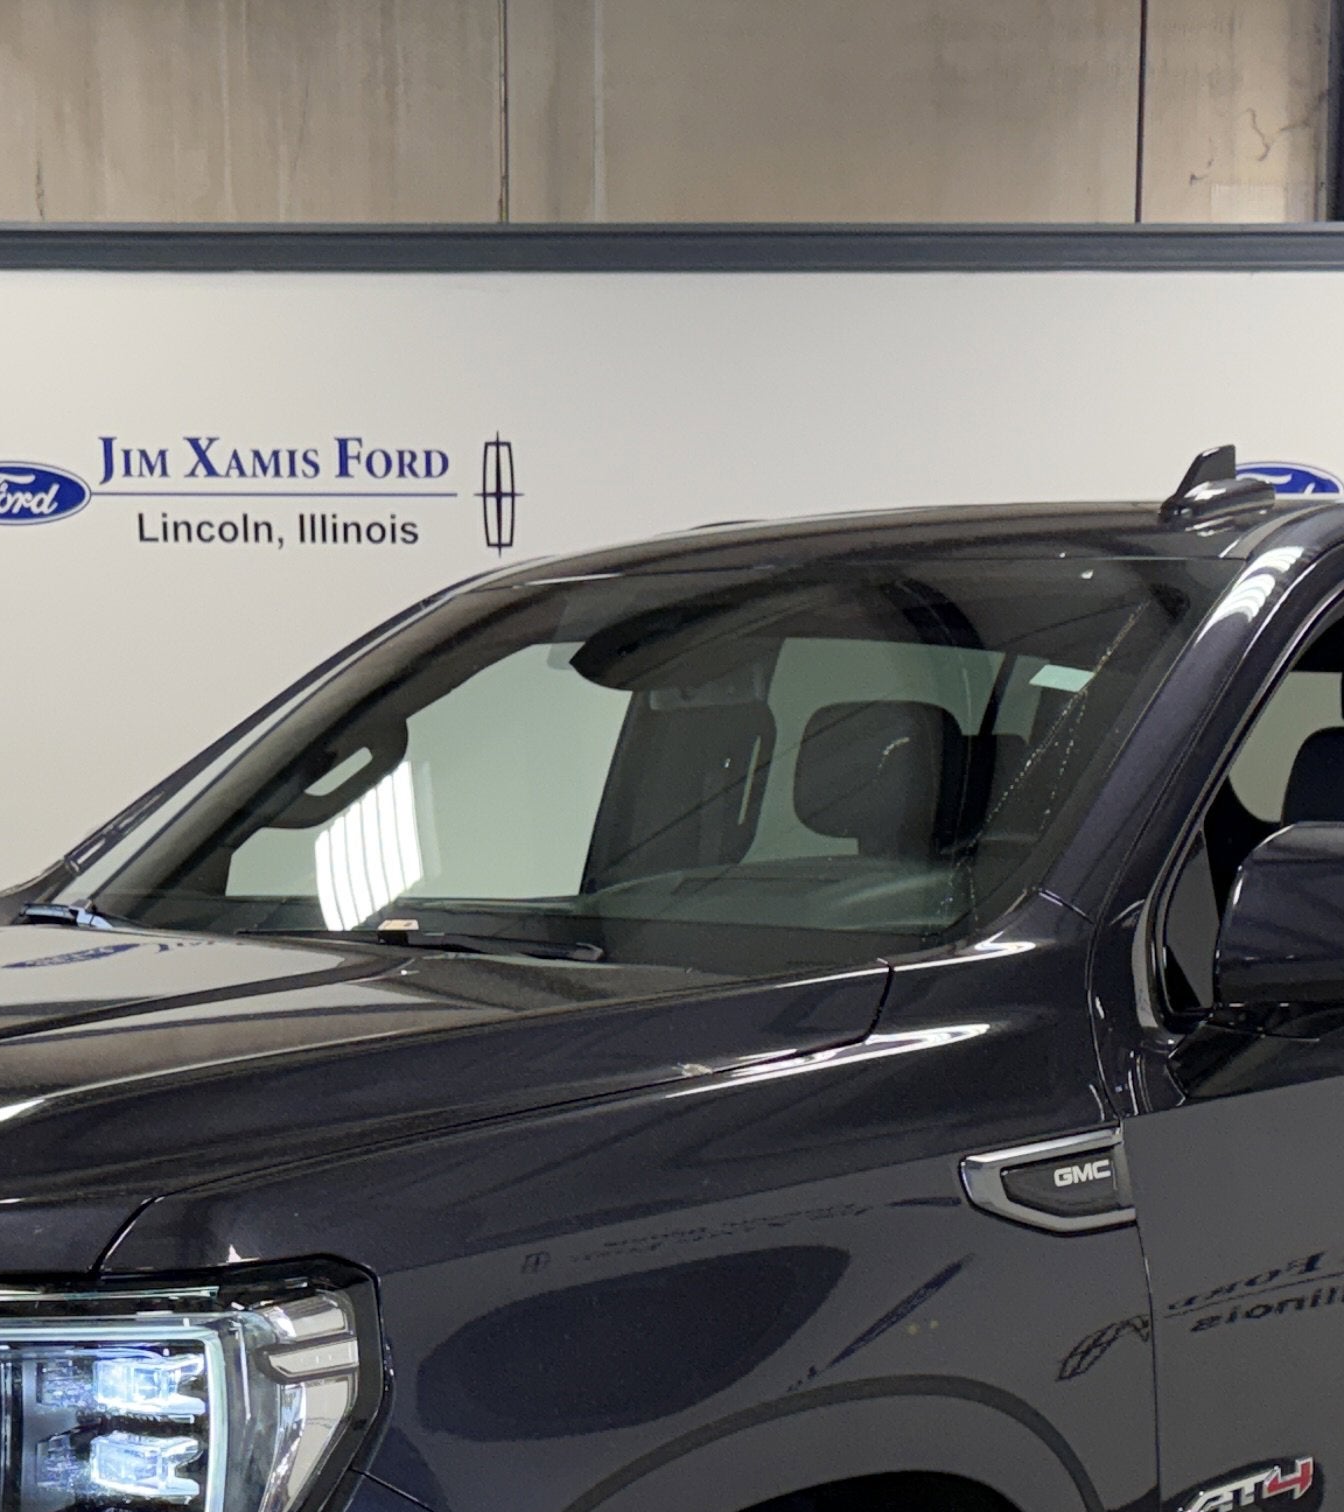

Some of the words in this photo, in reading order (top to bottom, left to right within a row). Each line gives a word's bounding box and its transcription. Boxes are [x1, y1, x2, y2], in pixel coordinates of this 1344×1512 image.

[98, 436, 168, 482] JIM
[182, 436, 321, 479] XAMIS
[334, 436, 450, 479] FORD
[137, 513, 284, 549] Lincoln,
[299, 513, 420, 544] Illinois
[1054, 1159, 1111, 1187] GMC
